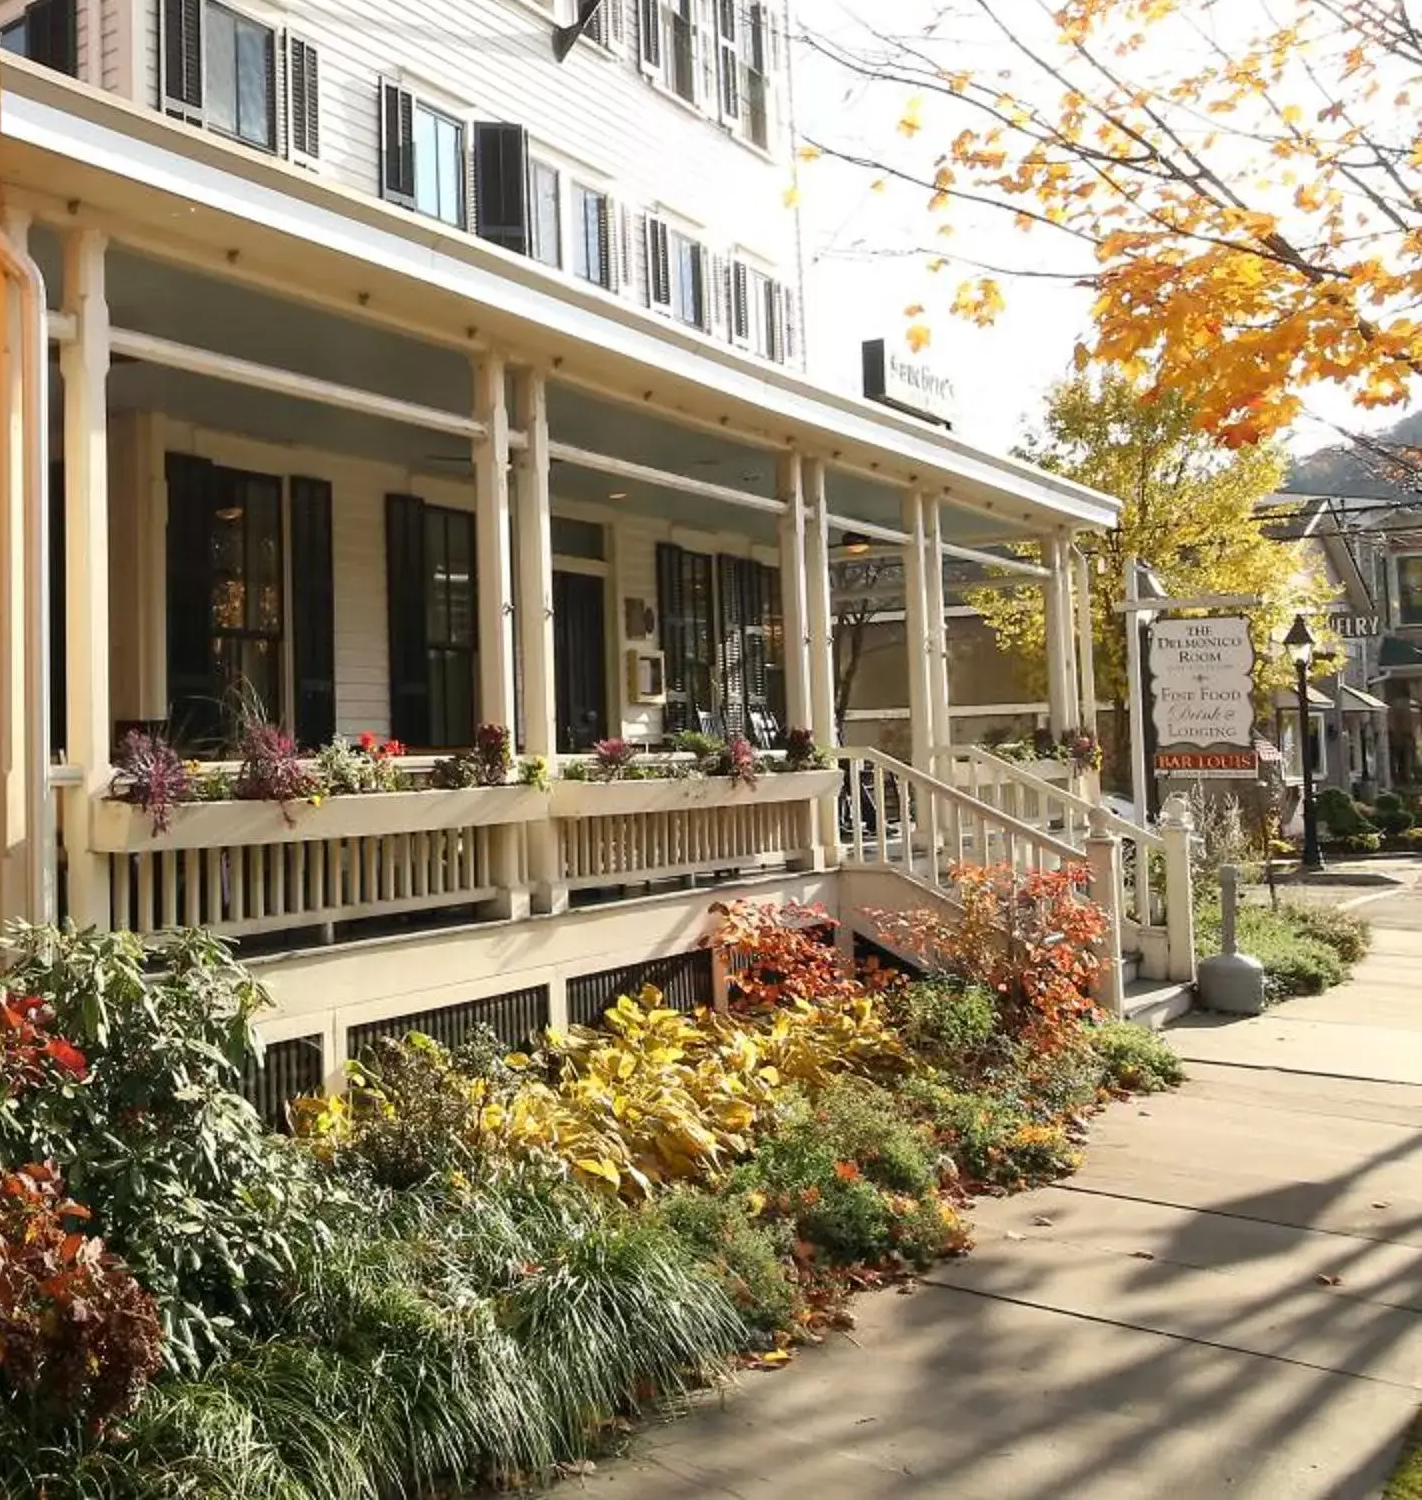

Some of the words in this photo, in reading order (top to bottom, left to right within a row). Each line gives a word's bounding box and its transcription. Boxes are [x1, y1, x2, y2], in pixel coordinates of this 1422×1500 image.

[1186, 625, 1213, 637] THE
[1157, 637, 1242, 650] DELMONICO
[1179, 651, 1222, 664] ROOM
[1201, 687, 1241, 701] FOOD
[1168, 723, 1237, 738] LODGING
[1159, 755, 1192, 769] BAR
[1198, 755, 1251, 769] LOUIS
